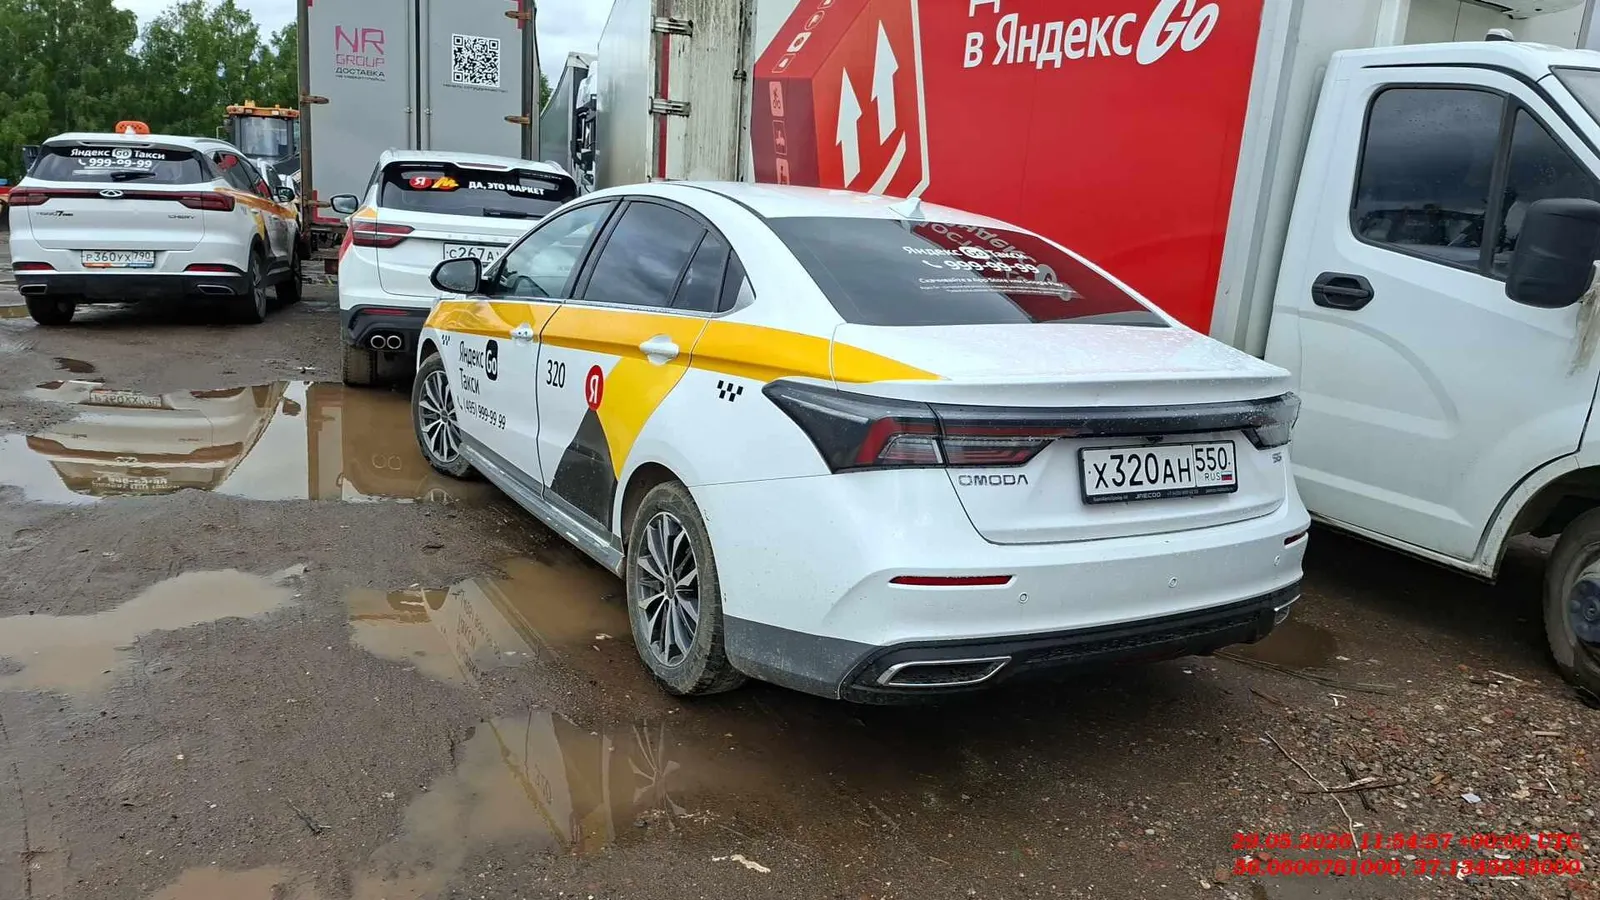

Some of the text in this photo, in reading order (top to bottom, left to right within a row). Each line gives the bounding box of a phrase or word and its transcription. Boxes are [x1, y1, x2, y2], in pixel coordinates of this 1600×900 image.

[335, 25, 385, 55] NR
[963, 0, 1219, 69] в Яндекс Go
[336, 54, 385, 68] GROUP
[335, 67, 385, 77] ДОСТАВКА
[70, 148, 110, 157] Яндекс
[134, 150, 165, 160] Такси
[414, 177, 425, 186] Я
[468, 181, 545, 195] ДА, ЭТО МАРКЕТ
[86, 251, 150, 262] Р360УХ 790
[902, 246, 963, 257] Яндекс
[944, 260, 1040, 274] 999-99-99
[459, 340, 498, 378] Яндекс Go
[546, 359, 566, 388] 320
[459, 368, 480, 395] Такси
[588, 374, 599, 404] Я
[464, 400, 478, 418] (495)
[498, 413, 507, 430] 99
[1094, 446, 1228, 489] Х320АН 550
[958, 474, 1029, 486] OMODA
[1204, 472, 1221, 481] RUS
